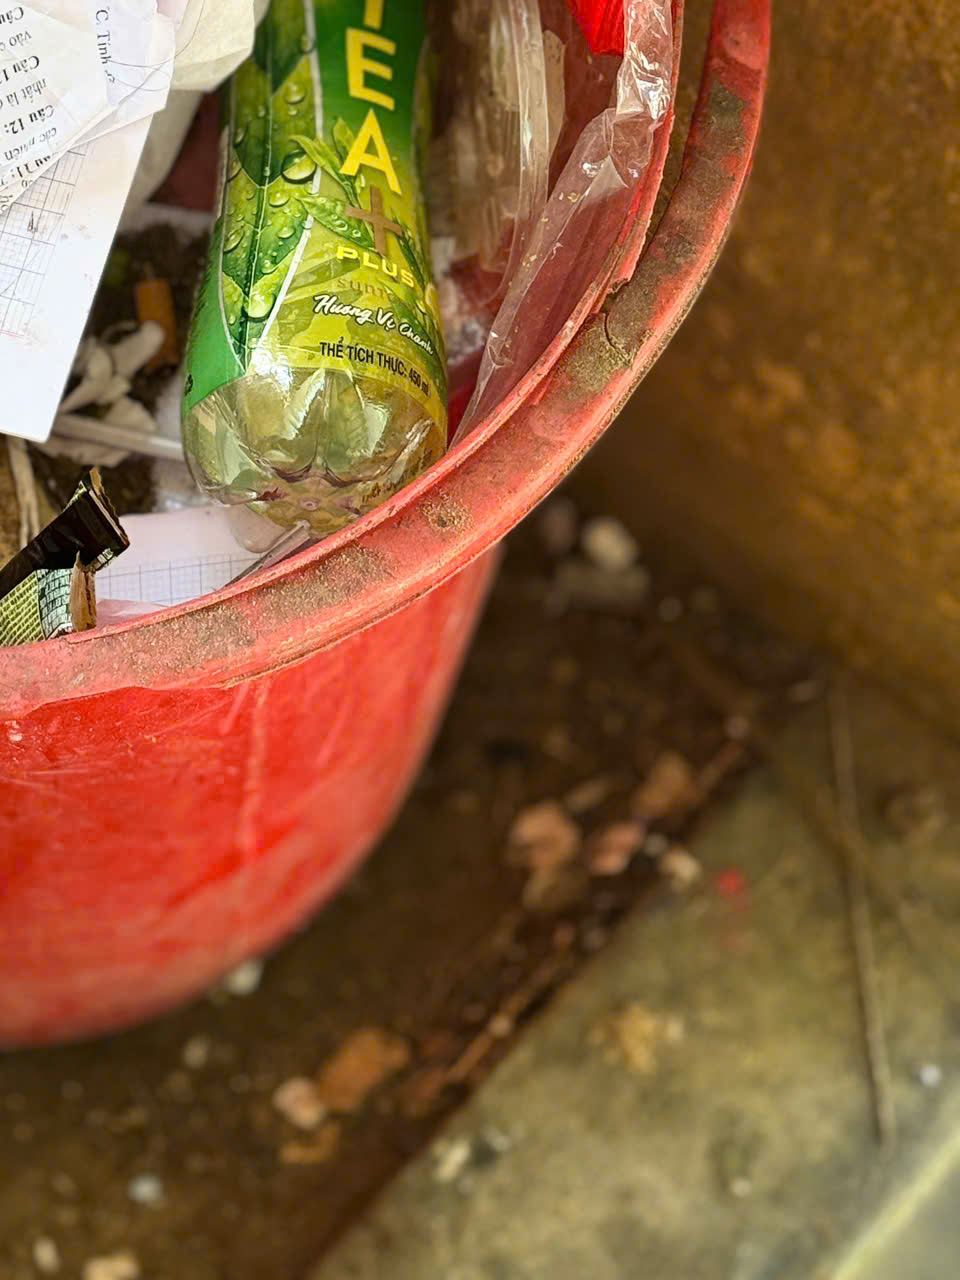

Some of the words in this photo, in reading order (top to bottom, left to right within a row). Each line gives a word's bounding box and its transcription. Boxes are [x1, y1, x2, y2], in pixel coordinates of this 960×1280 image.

[96, 8, 109, 24] C.
[9, 31, 31, 46] vào
[97, 32, 113, 64] Tính
[13, 56, 39, 73] Câu
[21, 79, 46, 99] nhất
[335, 245, 417, 289] PLUS
[375, 310, 398, 331] Vị
[397, 322, 435, 357] Chanh
[319, 336, 344, 360] THỂ
[346, 340, 375, 366] TÍCH
[376, 351, 408, 378] THỰC:
[407, 367, 422, 389] 450
